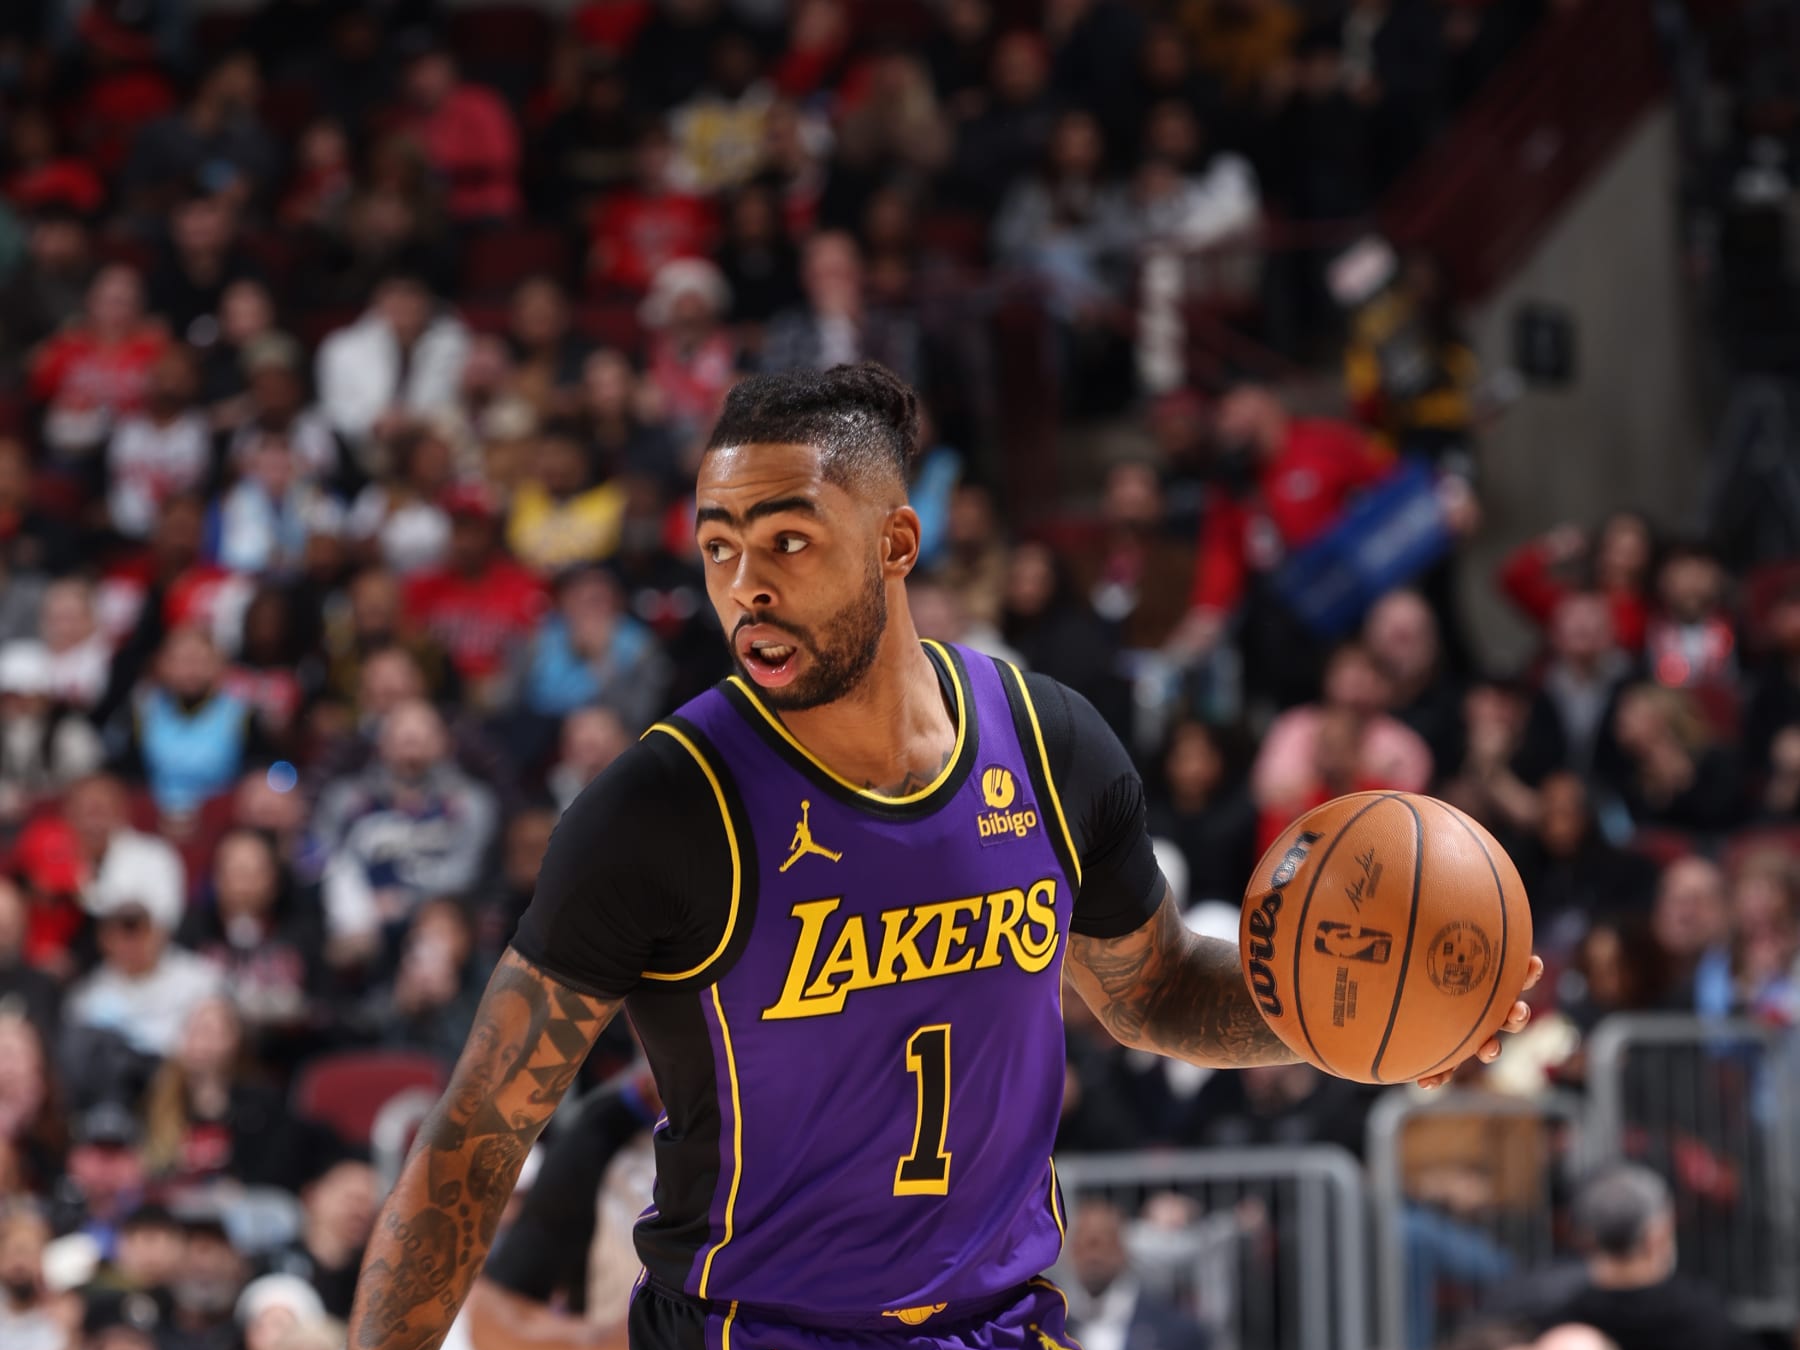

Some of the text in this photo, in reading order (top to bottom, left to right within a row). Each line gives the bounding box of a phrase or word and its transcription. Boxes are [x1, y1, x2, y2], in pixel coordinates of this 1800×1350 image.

[977, 809, 1037, 838] bibigo
[760, 878, 1060, 1021] LAKERS
[893, 1023, 952, 1197] 1
